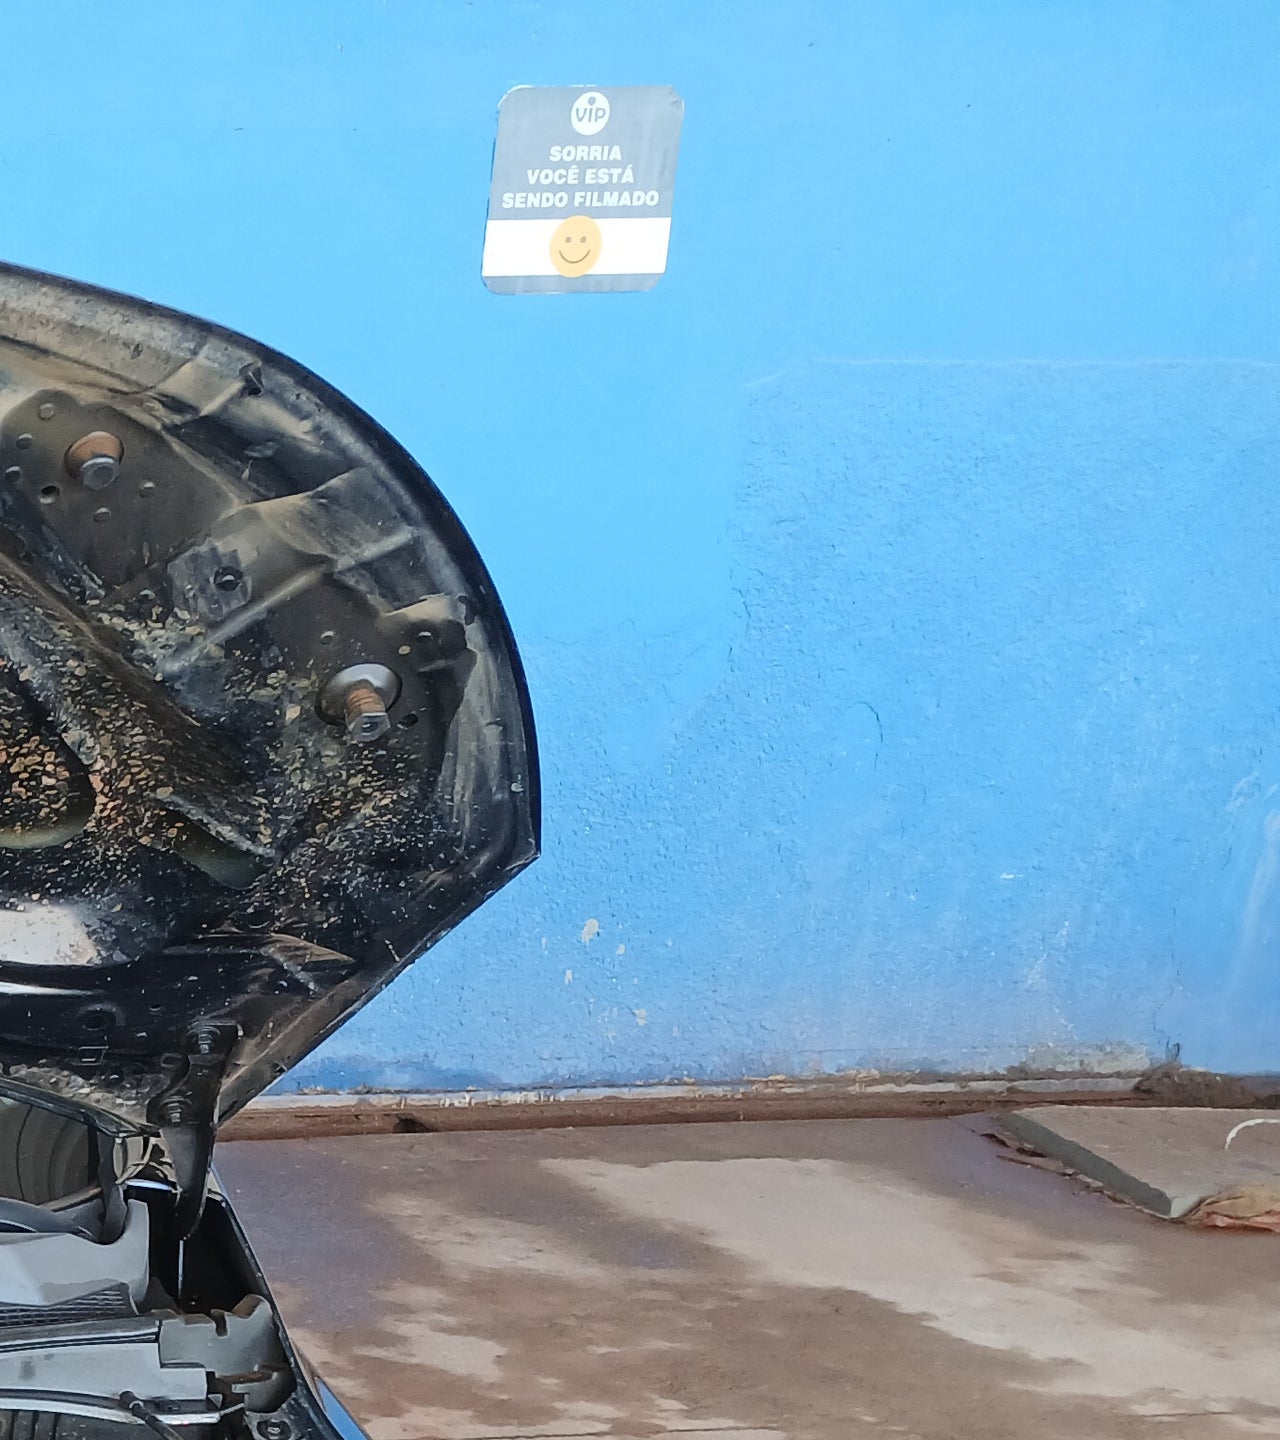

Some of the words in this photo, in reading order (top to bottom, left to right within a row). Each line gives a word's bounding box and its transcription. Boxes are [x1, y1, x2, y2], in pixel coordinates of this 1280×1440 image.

[549, 145, 622, 162] SORRIA
[526, 165, 579, 185] VOCÊ
[585, 164, 634, 184] ESTÁ
[502, 192, 568, 209] SENDO
[574, 190, 659, 207] FILMADO
